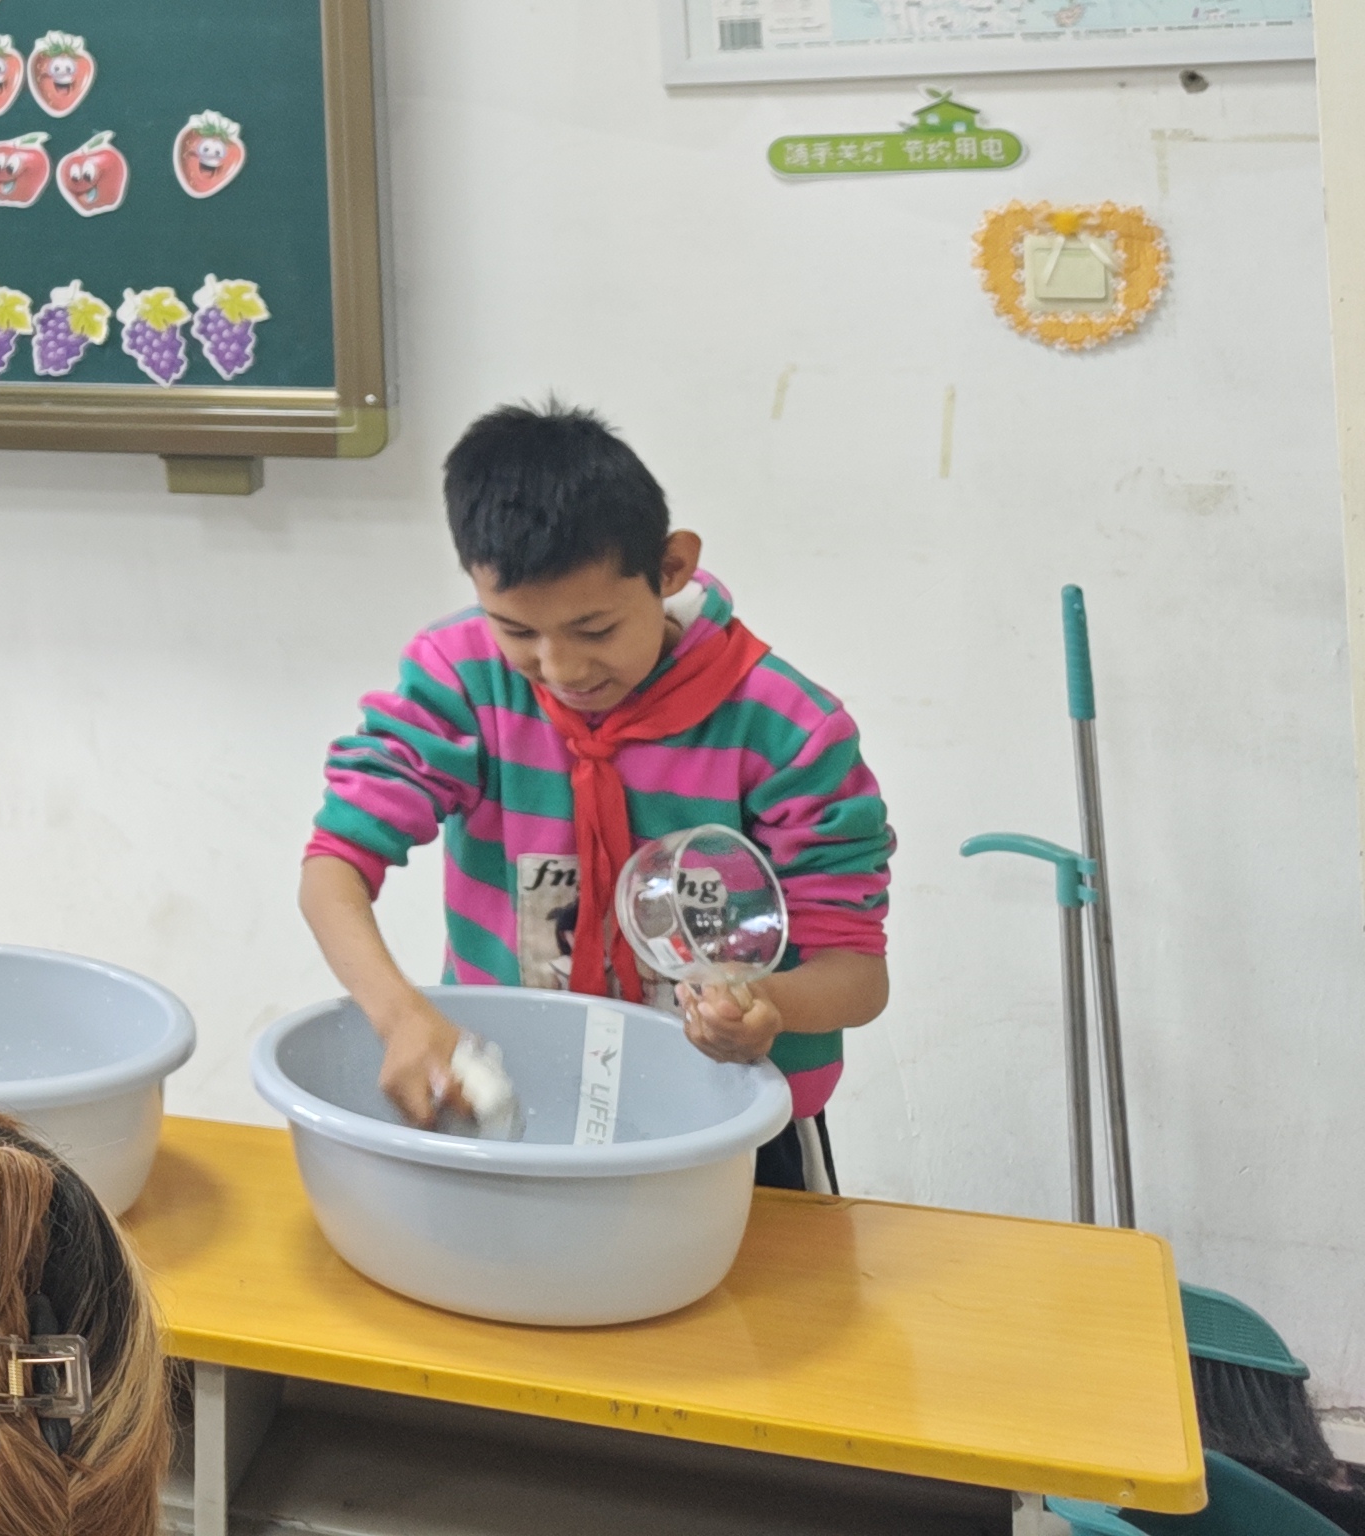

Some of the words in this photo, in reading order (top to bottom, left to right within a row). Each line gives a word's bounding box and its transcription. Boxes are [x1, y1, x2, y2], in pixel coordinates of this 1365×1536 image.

[784, 140, 885, 166] 随手关灯
[901, 136, 1007, 163] 节约用电
